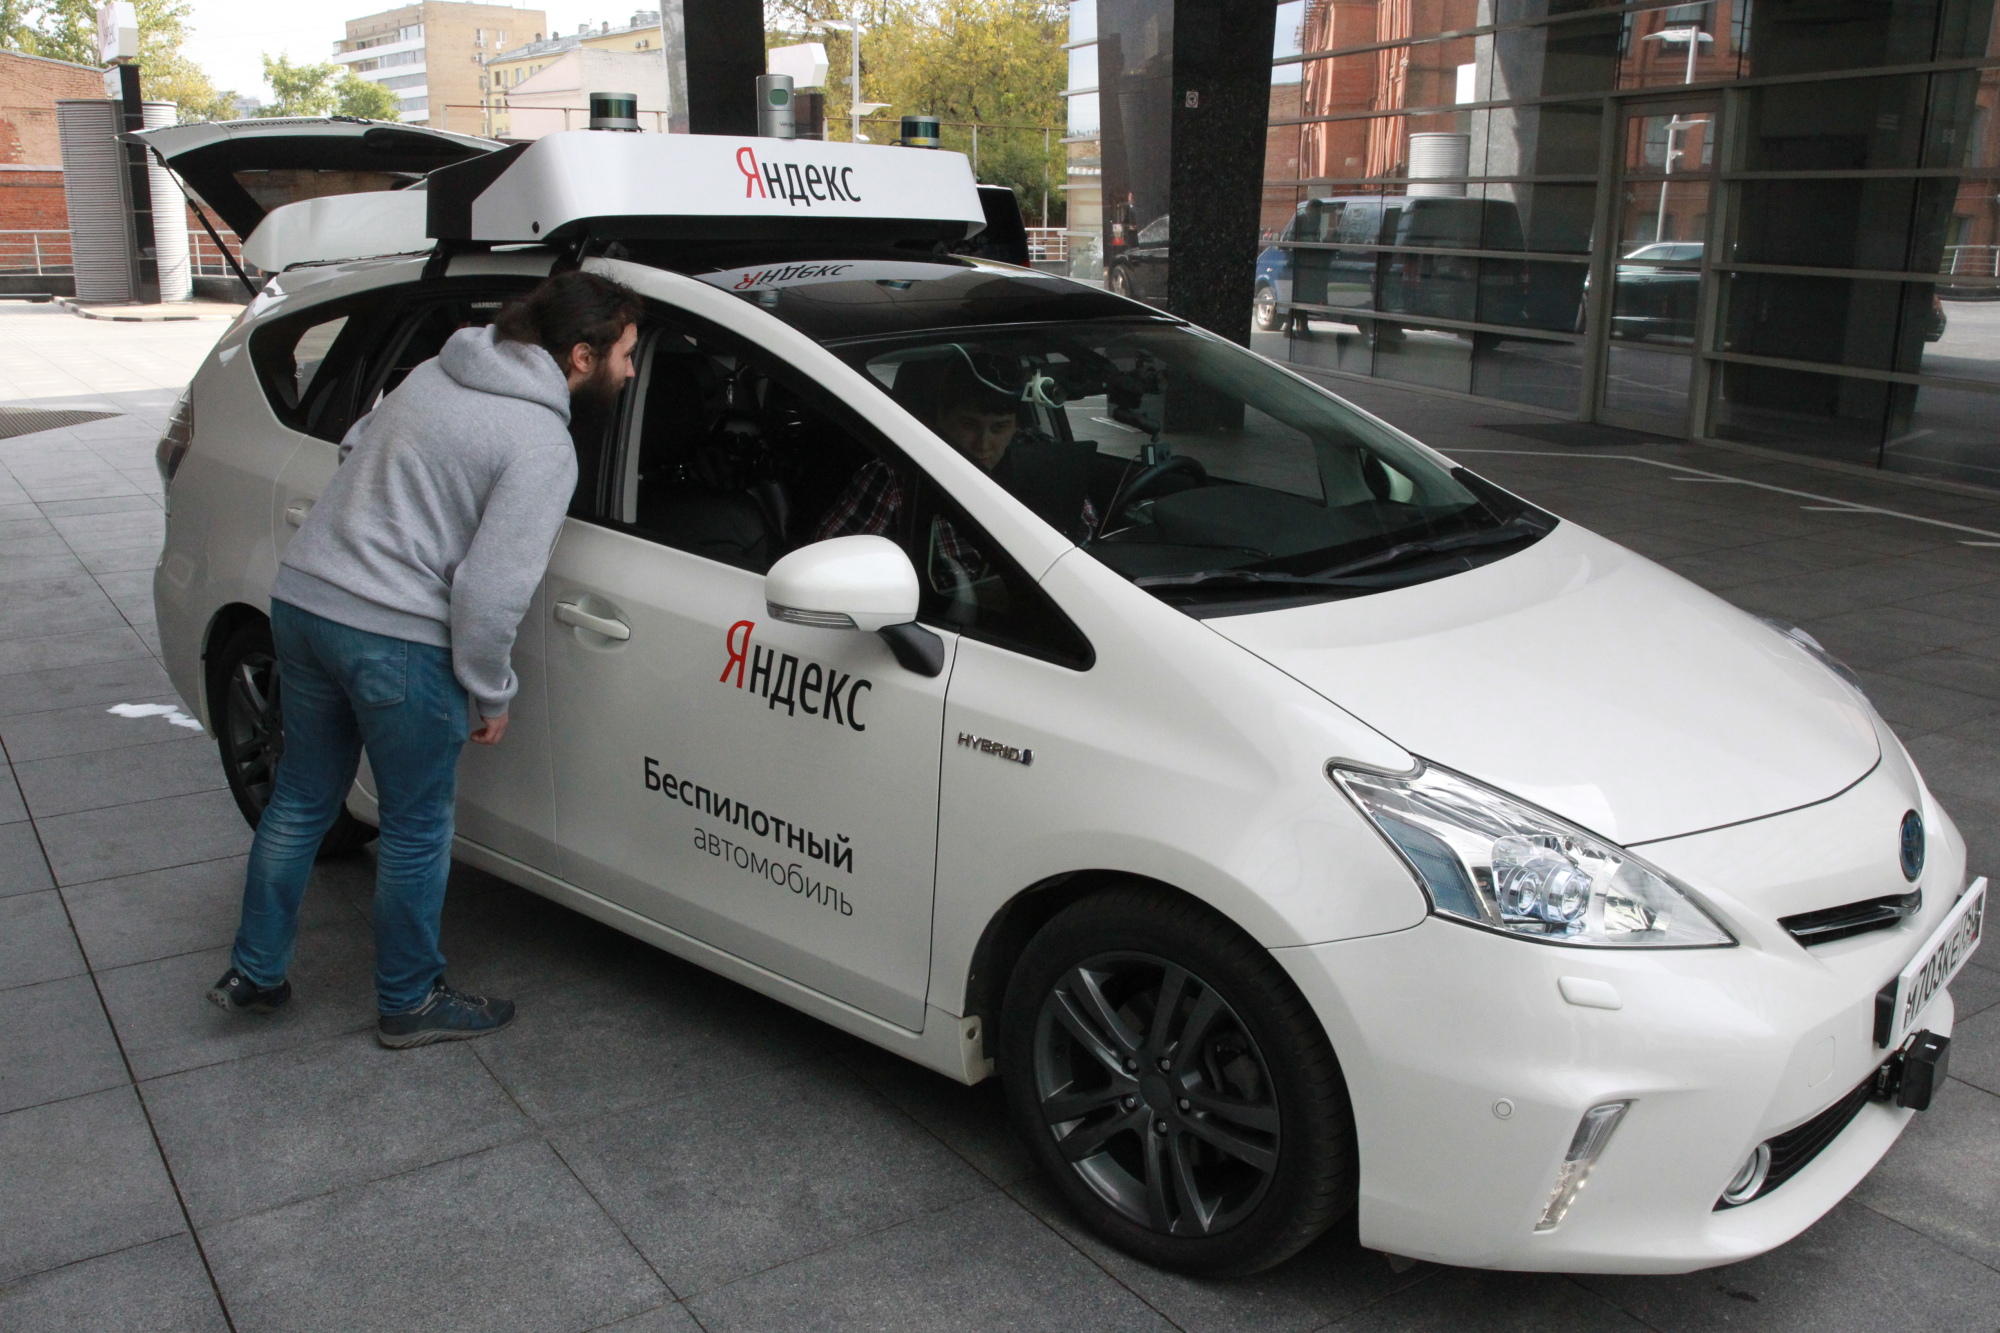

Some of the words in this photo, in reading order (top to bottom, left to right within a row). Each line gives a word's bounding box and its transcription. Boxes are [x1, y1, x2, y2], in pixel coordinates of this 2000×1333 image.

[736, 146, 862, 207] Яндекс
[719, 619, 873, 732] Яндекс
[958, 731, 1021, 762] HYBRID
[644, 755, 853, 874] Беспилотный
[694, 827, 853, 916] автомобиль
